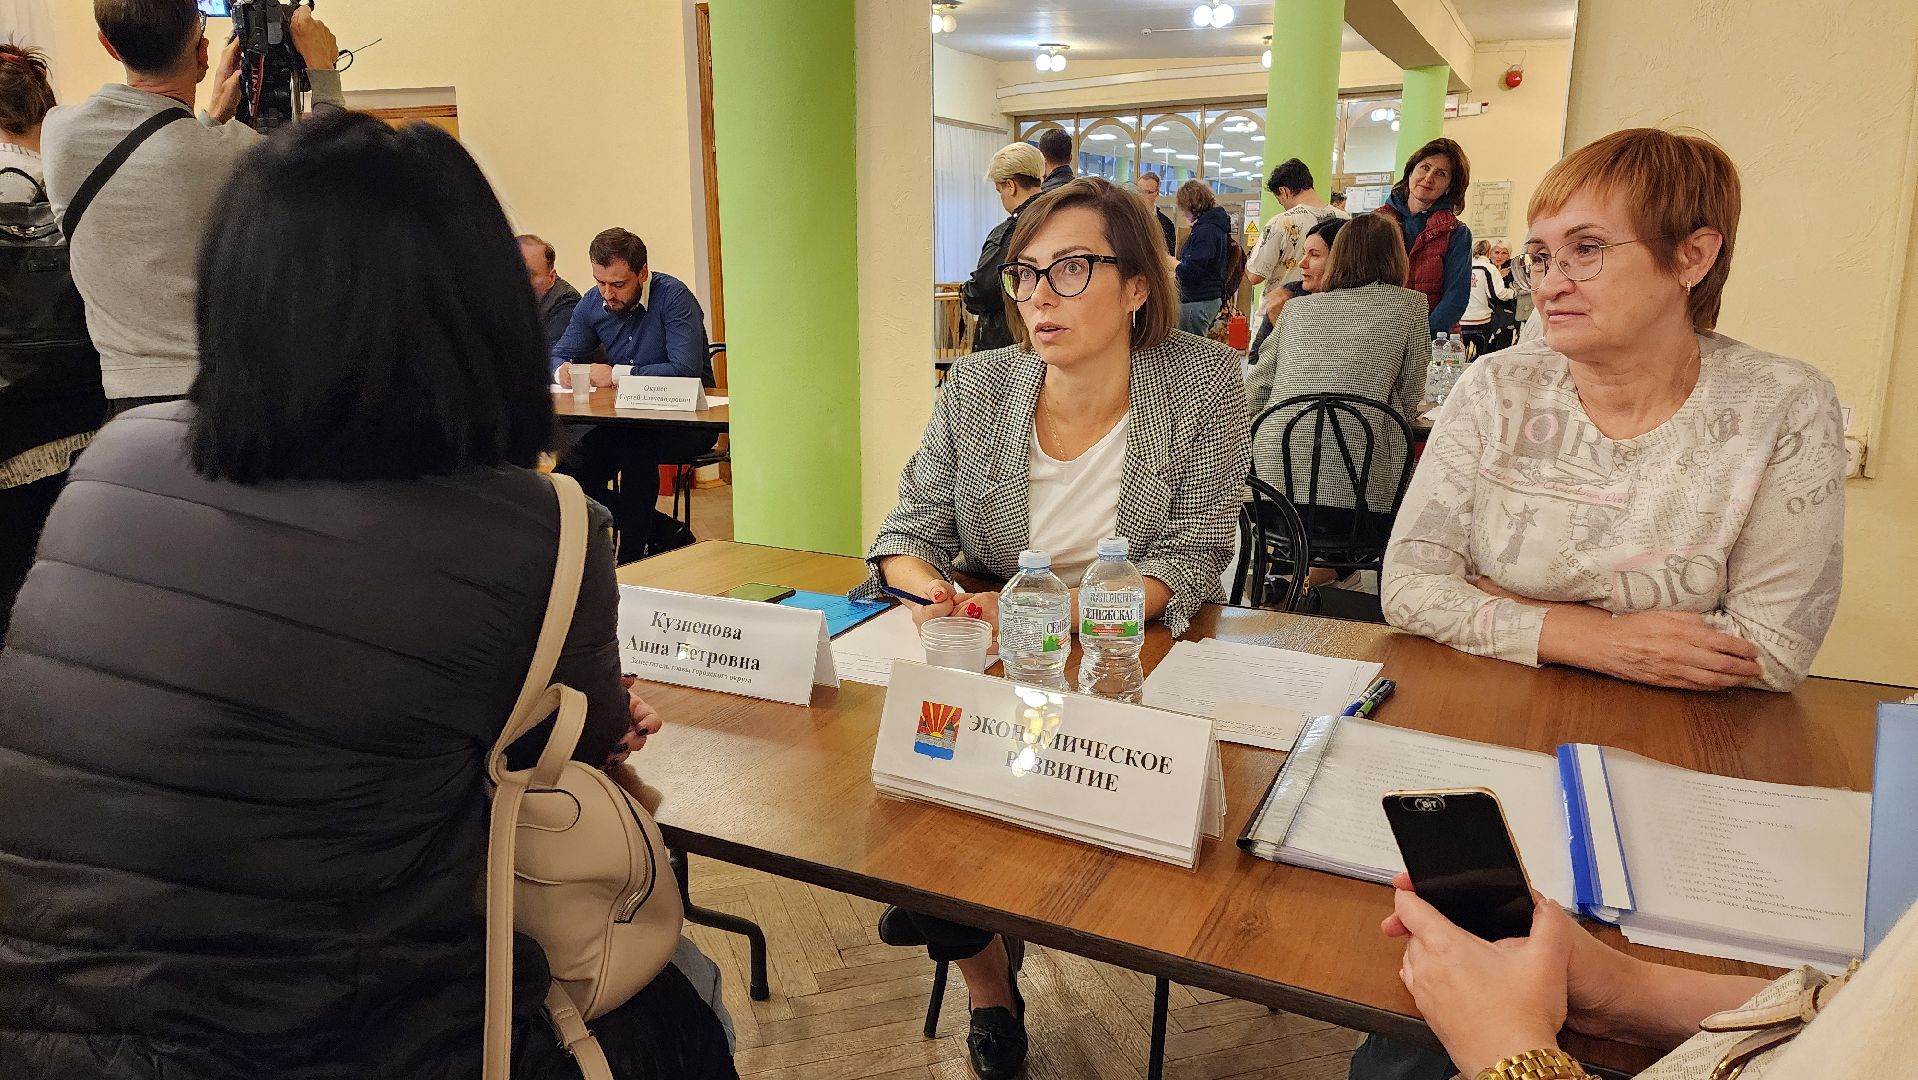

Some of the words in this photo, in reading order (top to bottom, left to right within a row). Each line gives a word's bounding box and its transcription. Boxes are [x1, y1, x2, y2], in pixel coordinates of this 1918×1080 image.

[650, 610, 742, 641] Кузнецова
[625, 634, 669, 657] Анна
[1006, 750, 1119, 792] РЗВИТИЕ
